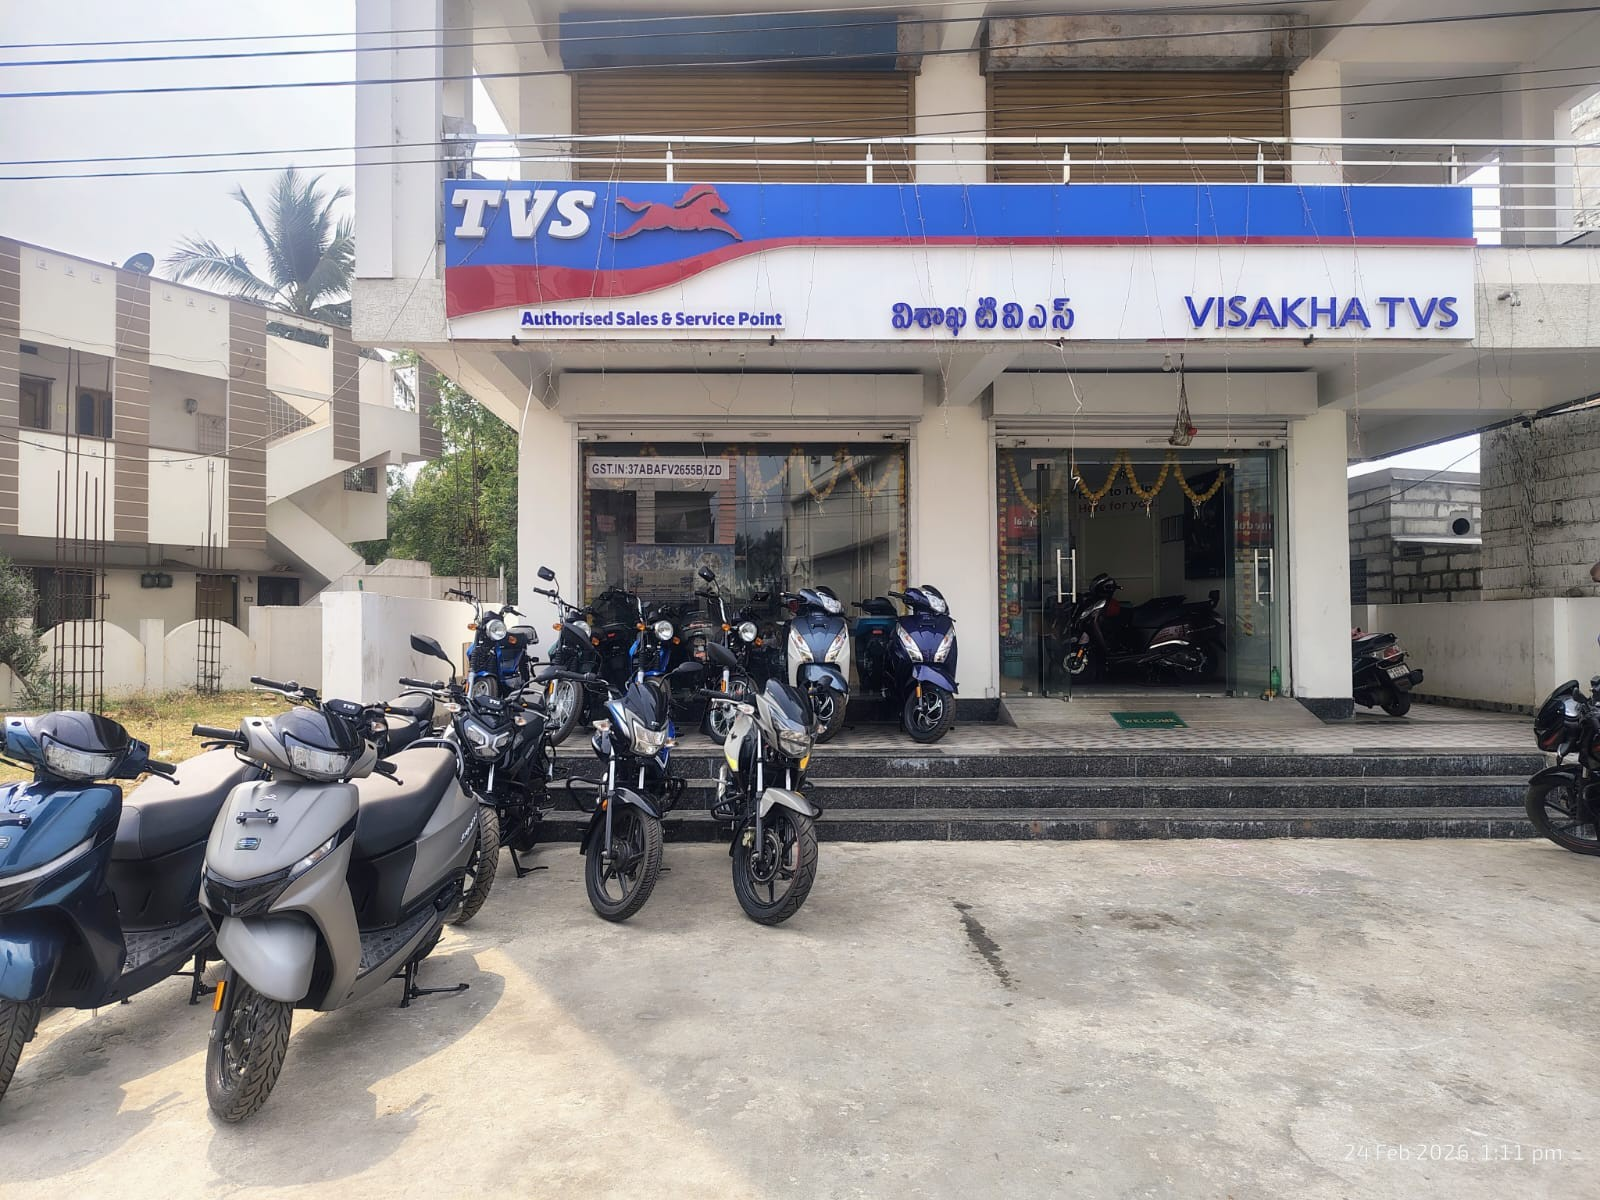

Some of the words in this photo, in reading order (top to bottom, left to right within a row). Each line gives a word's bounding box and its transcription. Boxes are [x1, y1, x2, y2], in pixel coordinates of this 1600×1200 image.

[451, 189, 597, 239] TVS
[521, 311, 613, 326] Authorised
[616, 311, 658, 326] Sales
[661, 312, 673, 326] &
[675, 311, 735, 326] Service
[738, 311, 783, 326] Point
[891, 302, 967, 336] విశాఖ
[1184, 295, 1371, 330] VISAKHA
[1378, 296, 1460, 330] TVS
